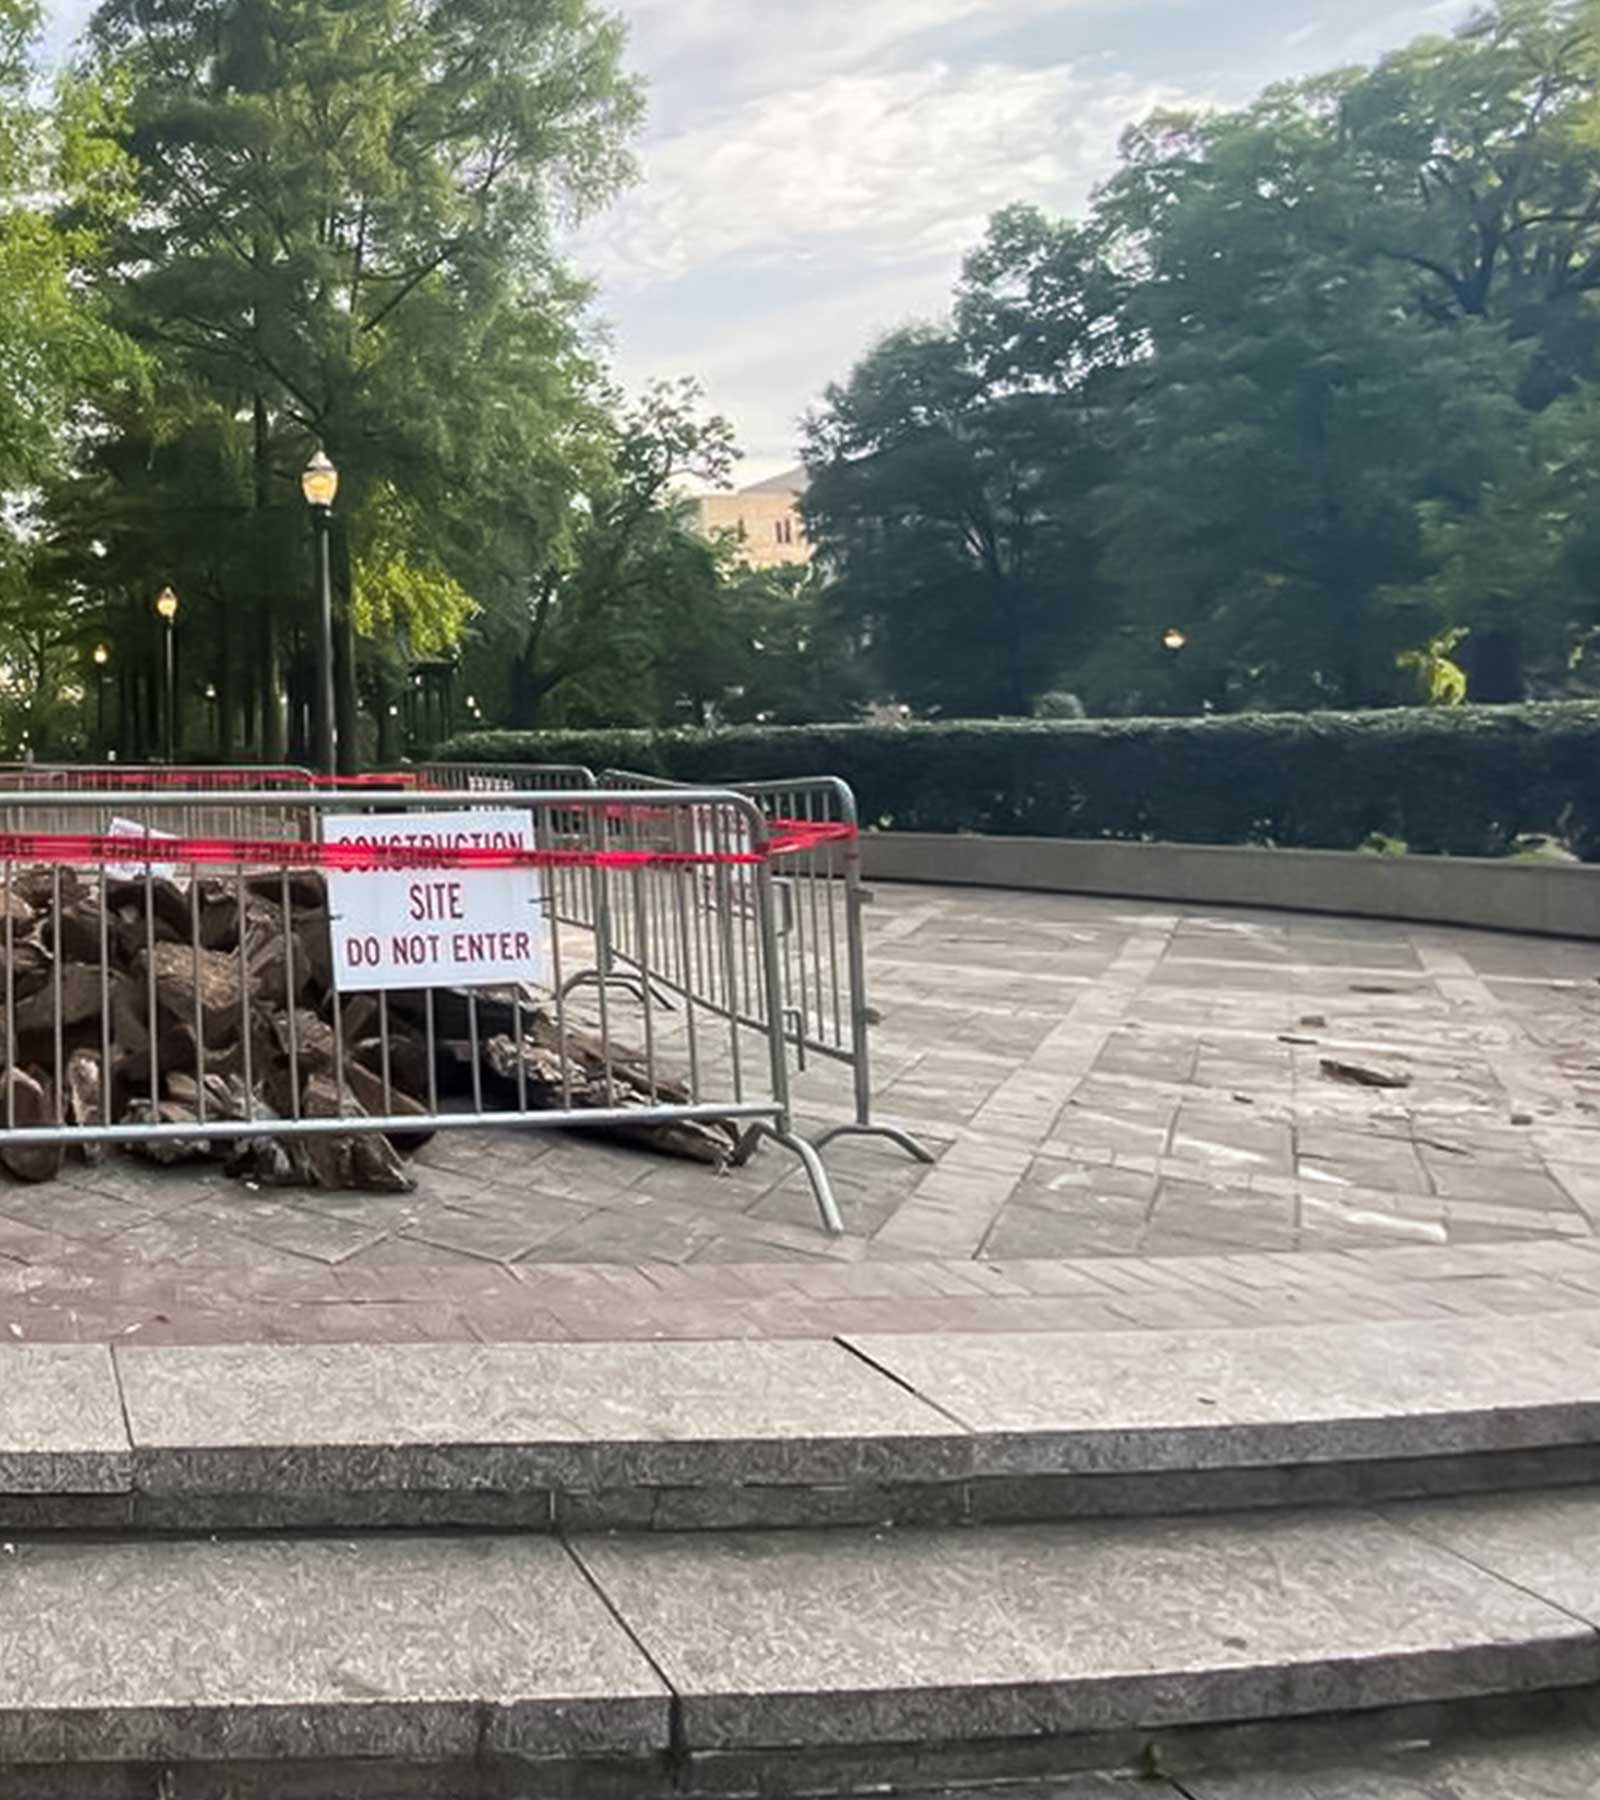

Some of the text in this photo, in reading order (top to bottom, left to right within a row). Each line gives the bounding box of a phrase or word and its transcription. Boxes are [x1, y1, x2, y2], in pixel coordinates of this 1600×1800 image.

[409, 883, 464, 920] SITE
[347, 932, 530, 966] DO NOT ENTER
